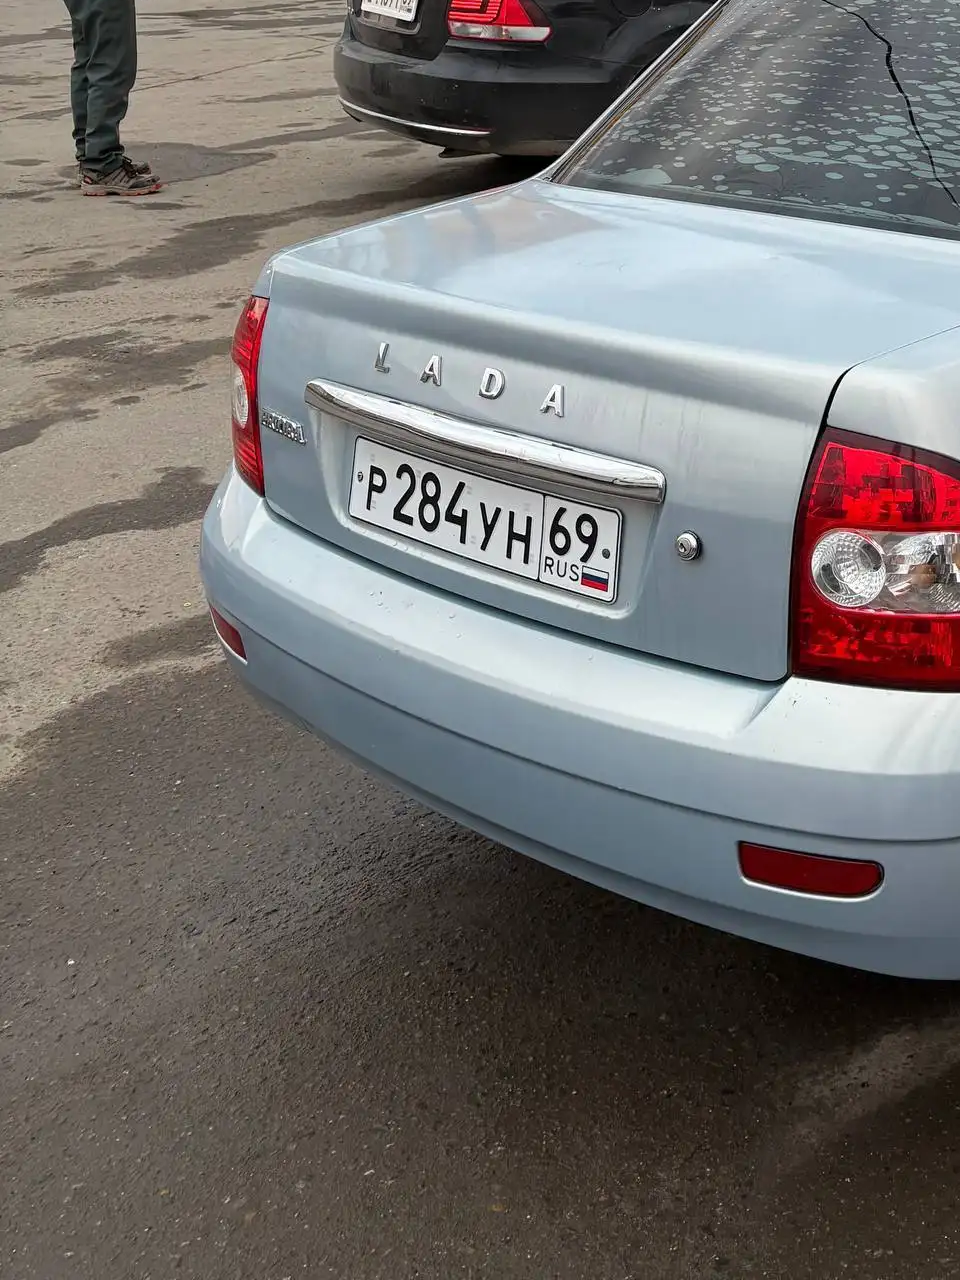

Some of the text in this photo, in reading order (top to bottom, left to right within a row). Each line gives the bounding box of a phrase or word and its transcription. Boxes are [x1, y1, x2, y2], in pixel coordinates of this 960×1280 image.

[373, 341, 567, 418] LADA
[549, 507, 599, 564] 69
[543, 556, 580, 583] RUS
